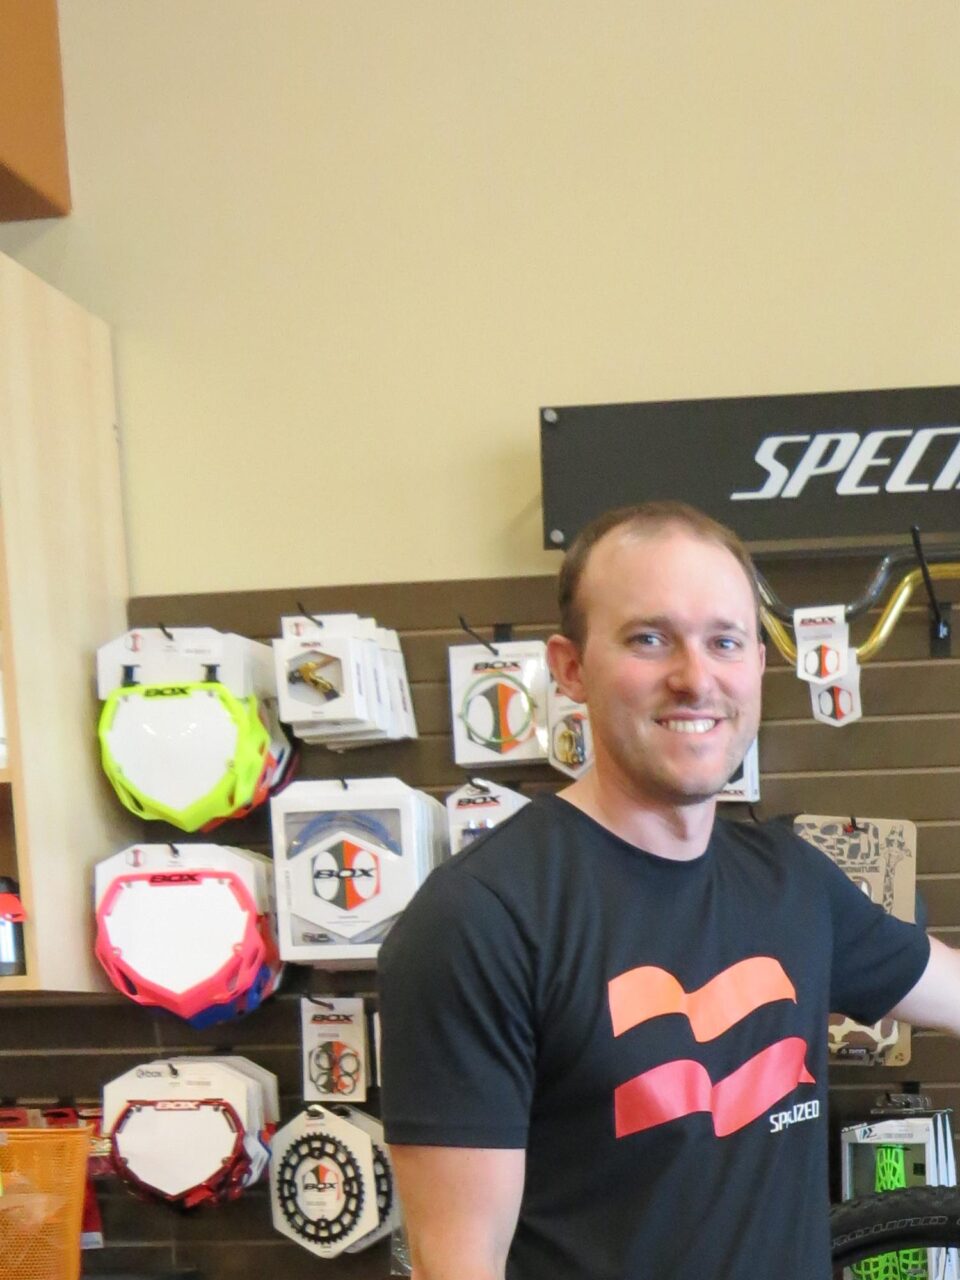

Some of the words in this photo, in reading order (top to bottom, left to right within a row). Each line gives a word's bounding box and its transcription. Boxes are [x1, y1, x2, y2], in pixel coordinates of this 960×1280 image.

[472, 661, 522, 672] BOX
[144, 686, 190, 698] BOX
[456, 795, 501, 807] BOX
[150, 873, 200, 883] BOX
[313, 867, 376, 880] BOX
[312, 1014, 355, 1022] BOX
[155, 1101, 200, 1111] BOX
[304, 1182, 338, 1191] BOX
